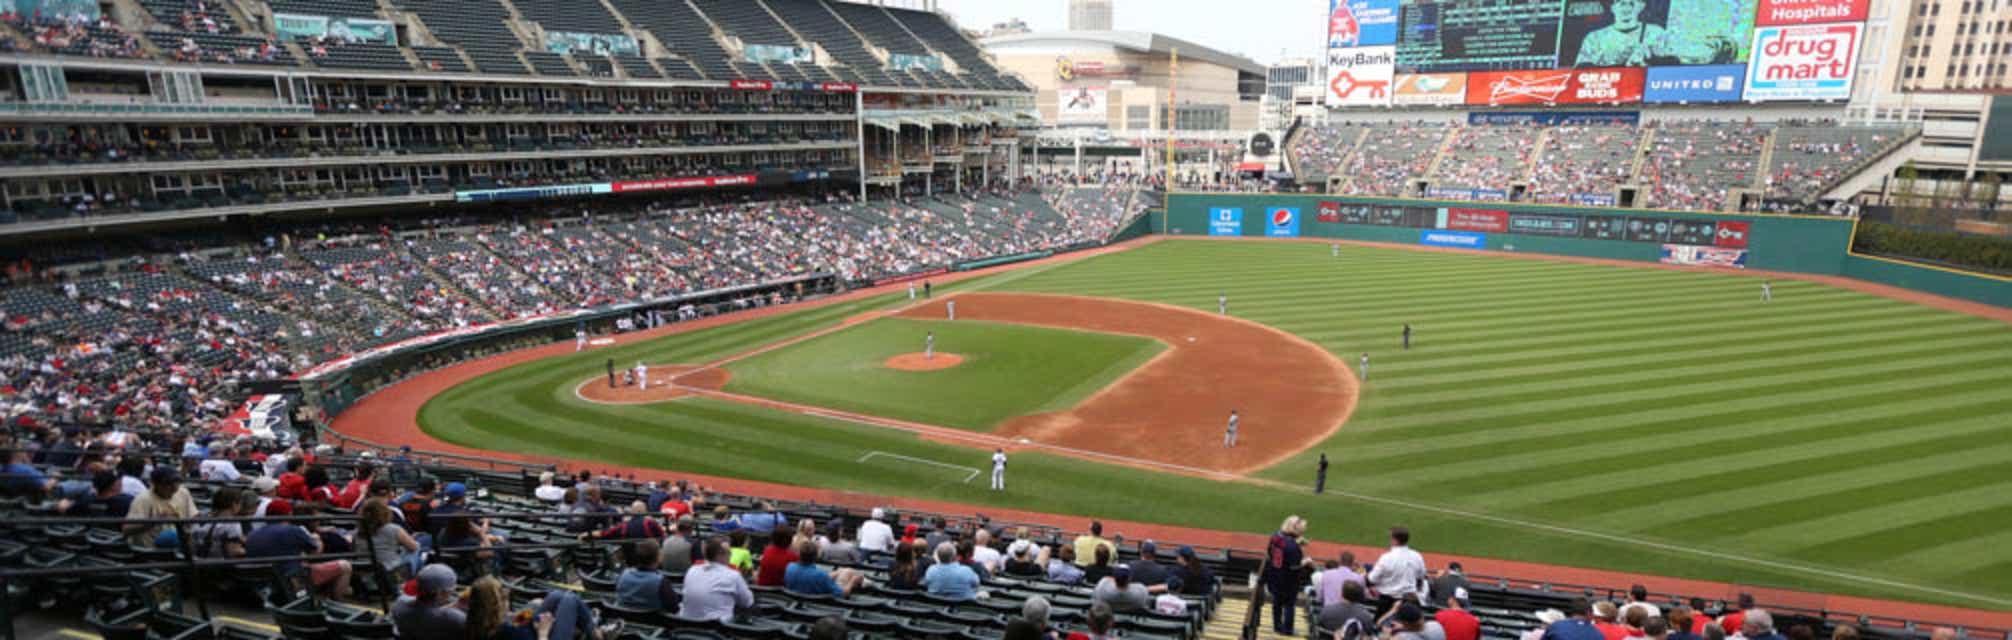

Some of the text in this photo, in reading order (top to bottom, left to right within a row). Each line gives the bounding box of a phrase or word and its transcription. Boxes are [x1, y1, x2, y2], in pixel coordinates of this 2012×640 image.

[1771, 3, 1851, 22] Hospitals
[1764, 28, 1838, 61] drug
[1330, 51, 1392, 68] KeyBank
[1766, 58, 1843, 80] mart
[1576, 88, 1618, 99] BUDS
[1651, 80, 1713, 90] UNITED
